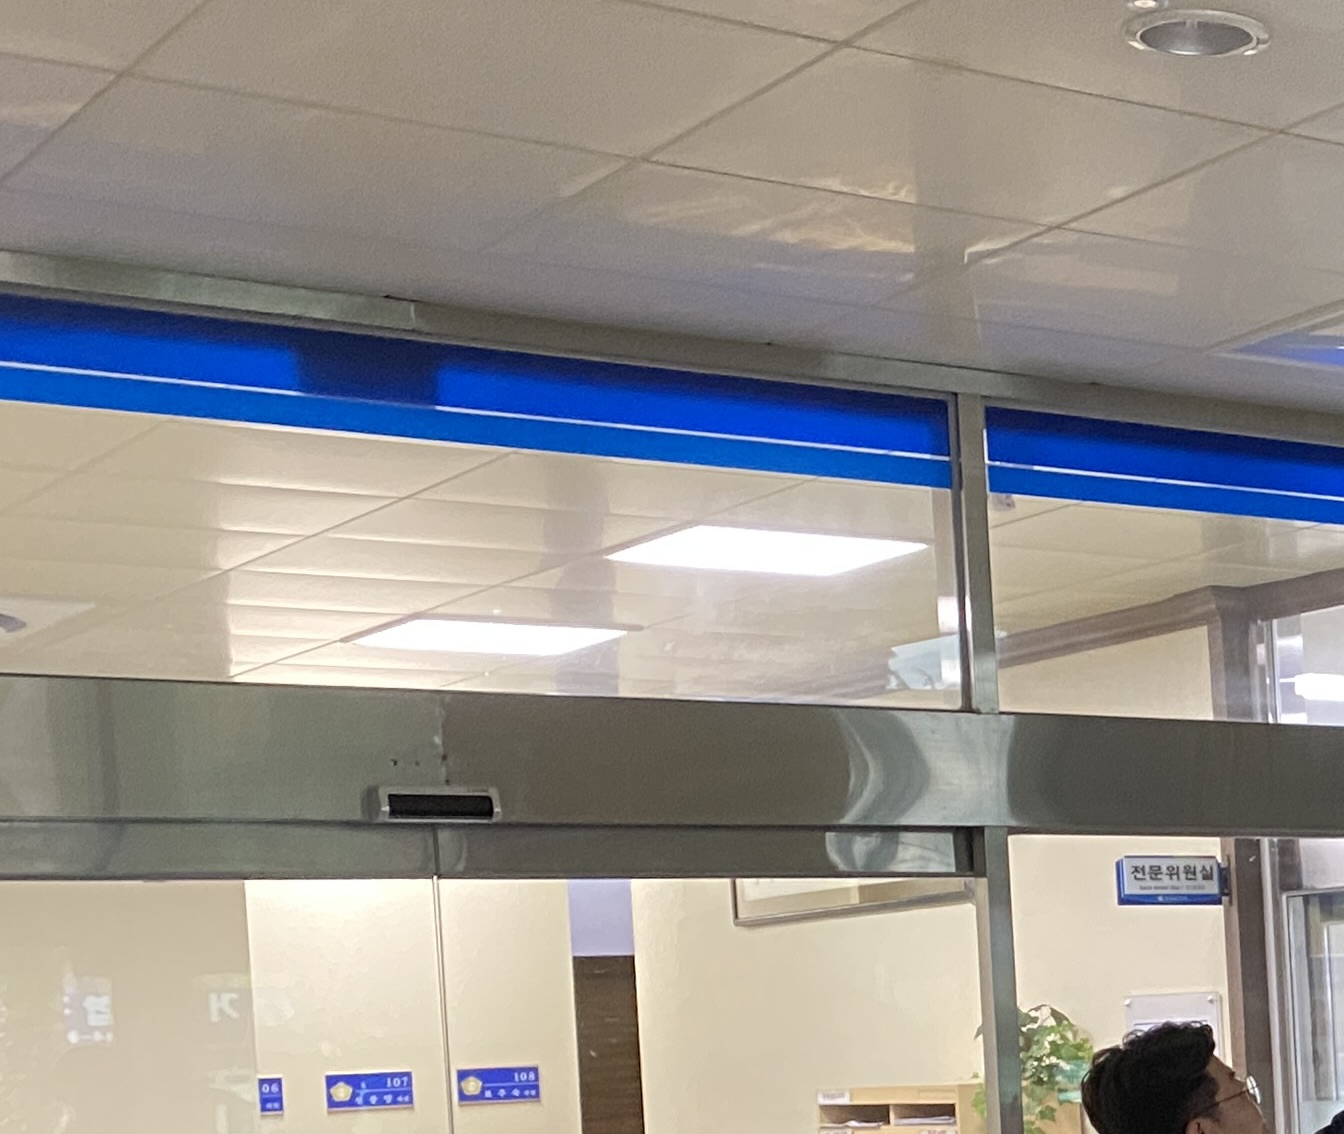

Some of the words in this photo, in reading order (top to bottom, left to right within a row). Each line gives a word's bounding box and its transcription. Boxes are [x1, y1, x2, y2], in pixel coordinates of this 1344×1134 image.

[1131, 864, 1214, 881] 전문위원실
[386, 1075, 409, 1088] 107
[514, 1070, 536, 1082] 108
